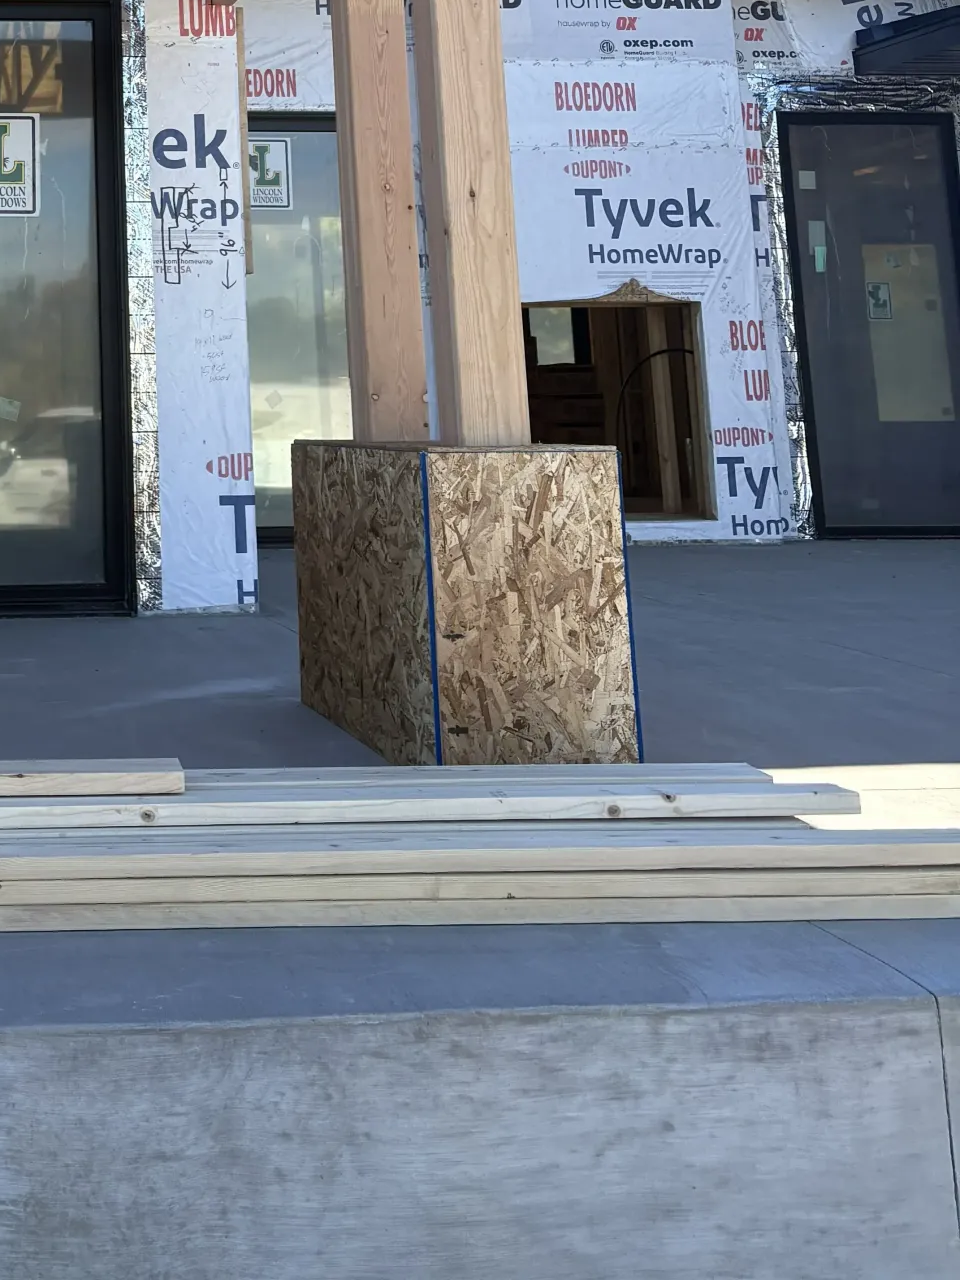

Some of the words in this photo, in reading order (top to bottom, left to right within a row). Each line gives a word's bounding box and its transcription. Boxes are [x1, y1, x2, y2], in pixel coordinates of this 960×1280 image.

[732, 0, 786, 22] eGU
[601, 19, 611, 29] by
[615, 17, 638, 31] OX
[743, 27, 765, 42] OX
[623, 39, 694, 49] oxep.com
[554, 81, 637, 112] BLOEDORN
[152, 114, 231, 169] ek
[571, 159, 624, 179] DUPONT
[253, 188, 283, 196] LINCOLN
[253, 196, 284, 204] WINDOWS
[574, 187, 715, 240] Tyvek
[588, 243, 722, 269] HomeWrap
[714, 426, 766, 448] DUPONT
